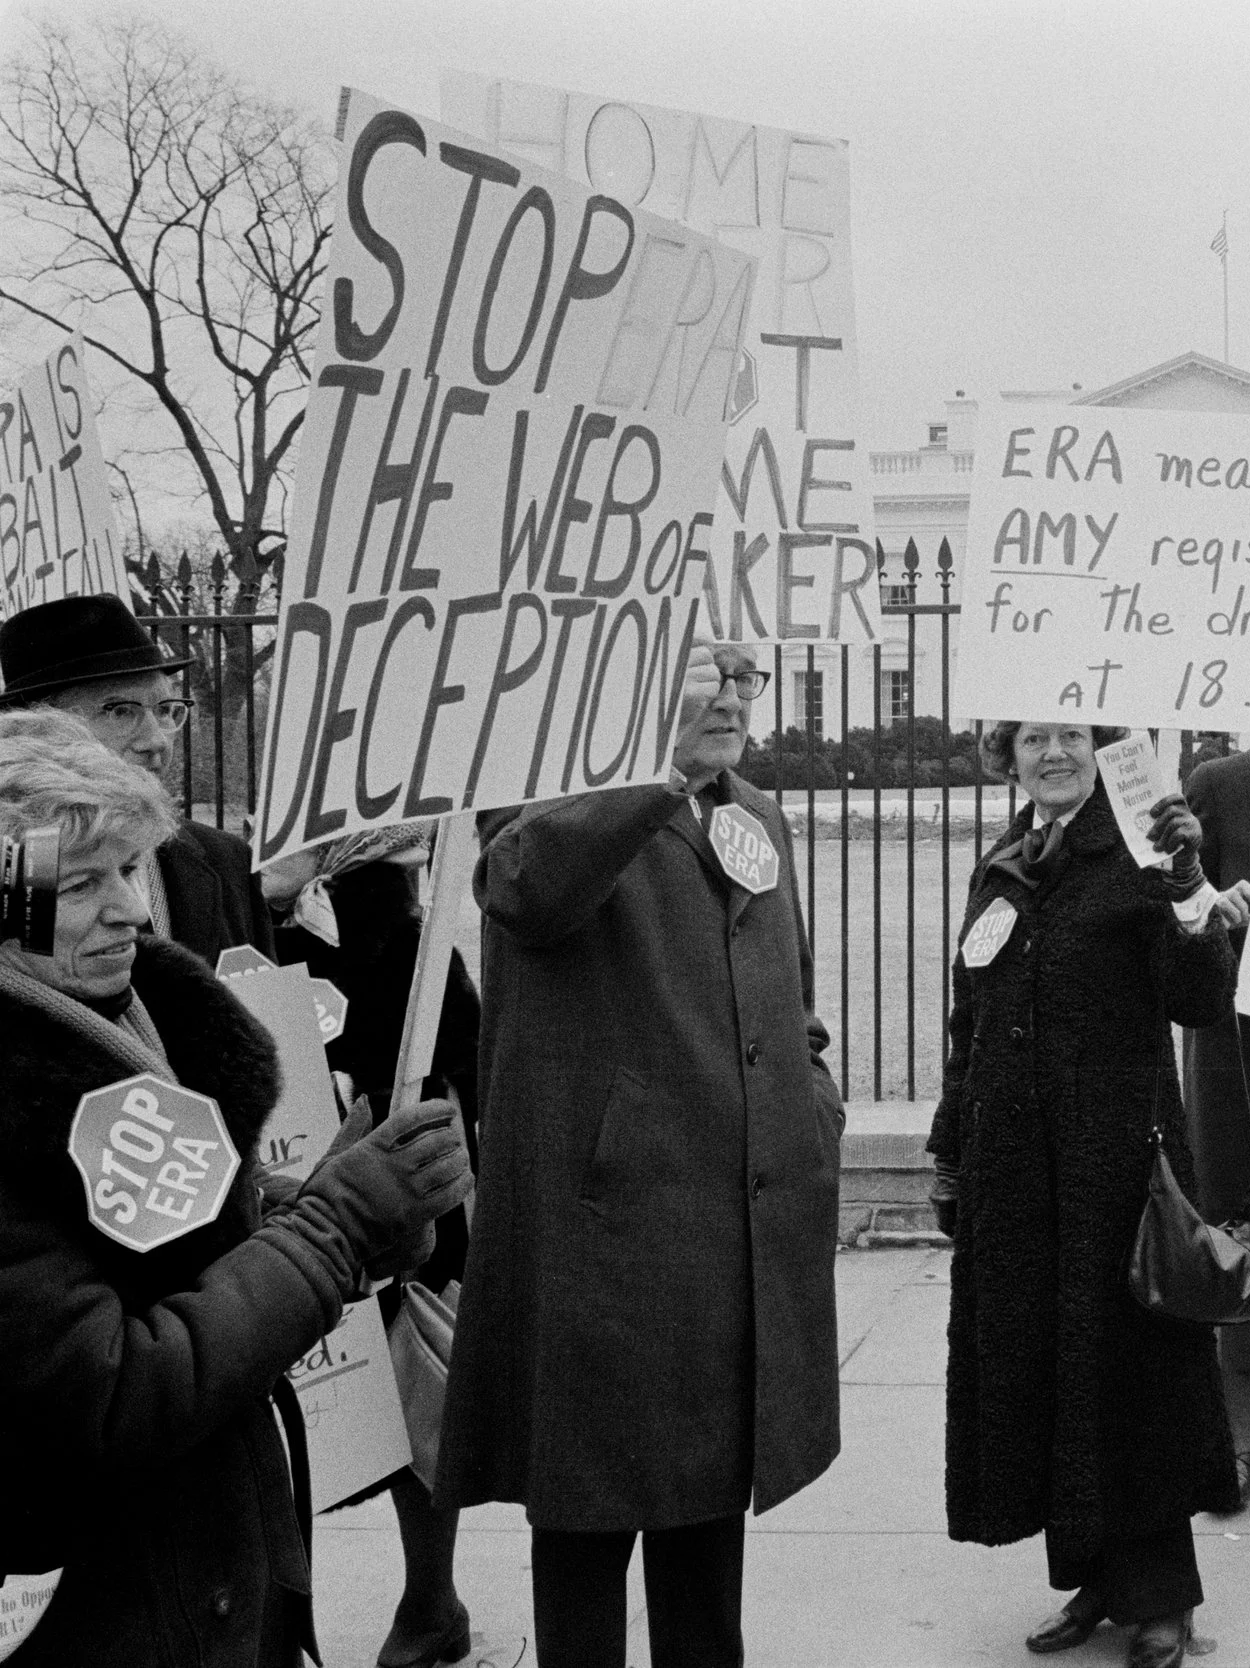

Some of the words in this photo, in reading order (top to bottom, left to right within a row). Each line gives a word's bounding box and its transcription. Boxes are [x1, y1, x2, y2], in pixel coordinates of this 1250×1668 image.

[488, 75, 836, 238] HOME
[333, 109, 635, 394] STOP
[45, 344, 82, 455] IS
[304, 363, 491, 600] THE
[500, 404, 662, 599] WEB
[644, 511, 715, 598] OF
[1001, 425, 1123, 485] ERA
[992, 507, 1120, 573] AMY
[985, 582, 1054, 633] for
[259, 591, 700, 863] DECEPTION
[1122, 789, 1153, 808] Nature
[718, 811, 774, 866] STOP
[724, 843, 761, 886] ERA
[971, 936, 999, 958] ERA
[972, 907, 1016, 940] STOP
[94, 1087, 175, 1225] STOP
[145, 1136, 219, 1221] ERA
